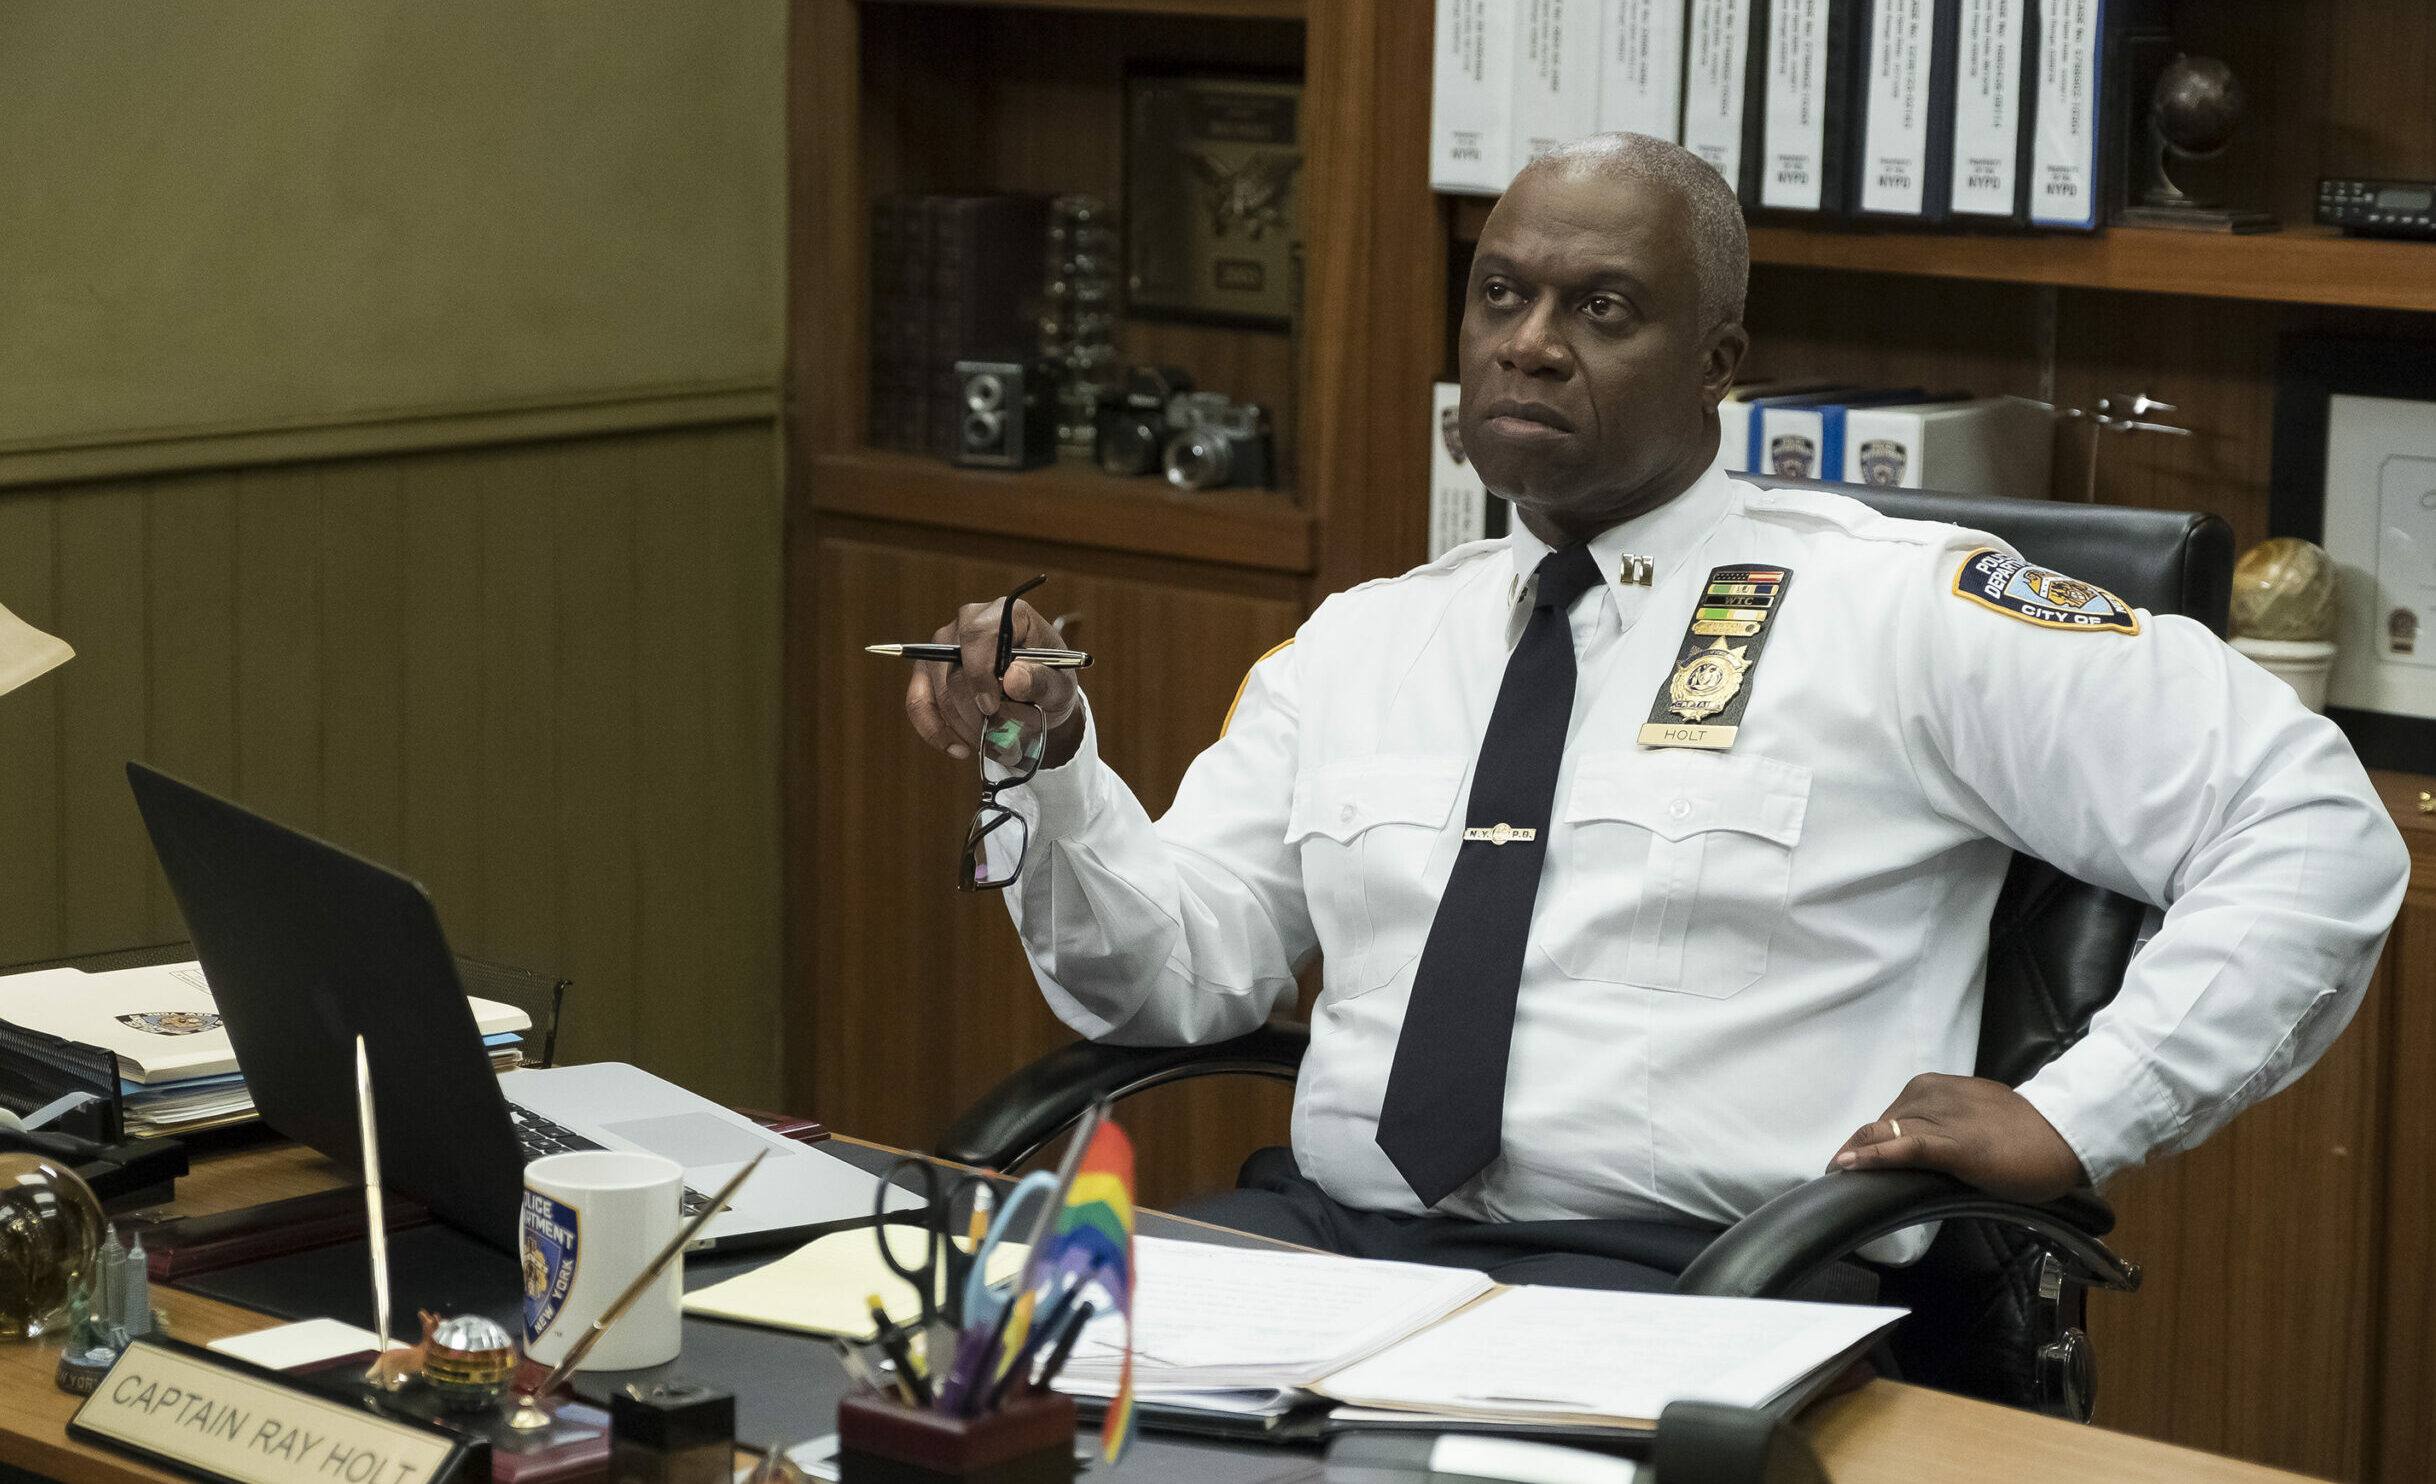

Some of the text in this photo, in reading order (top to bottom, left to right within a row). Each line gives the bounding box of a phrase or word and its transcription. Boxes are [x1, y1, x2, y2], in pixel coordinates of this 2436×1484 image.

[1777, 170, 1809, 185] NYPD
[1878, 175, 1911, 190] NYPD
[1967, 174, 2001, 190] NYPD
[2046, 182, 2078, 197] NYPD
[1724, 596, 1754, 605] WTC
[2021, 604, 2101, 625] CITY OF
[1664, 729, 1708, 741] HOLT
[534, 1259, 574, 1336] NEW YORK
[113, 1374, 417, 1484] CAPTAIN RAY HOLT
